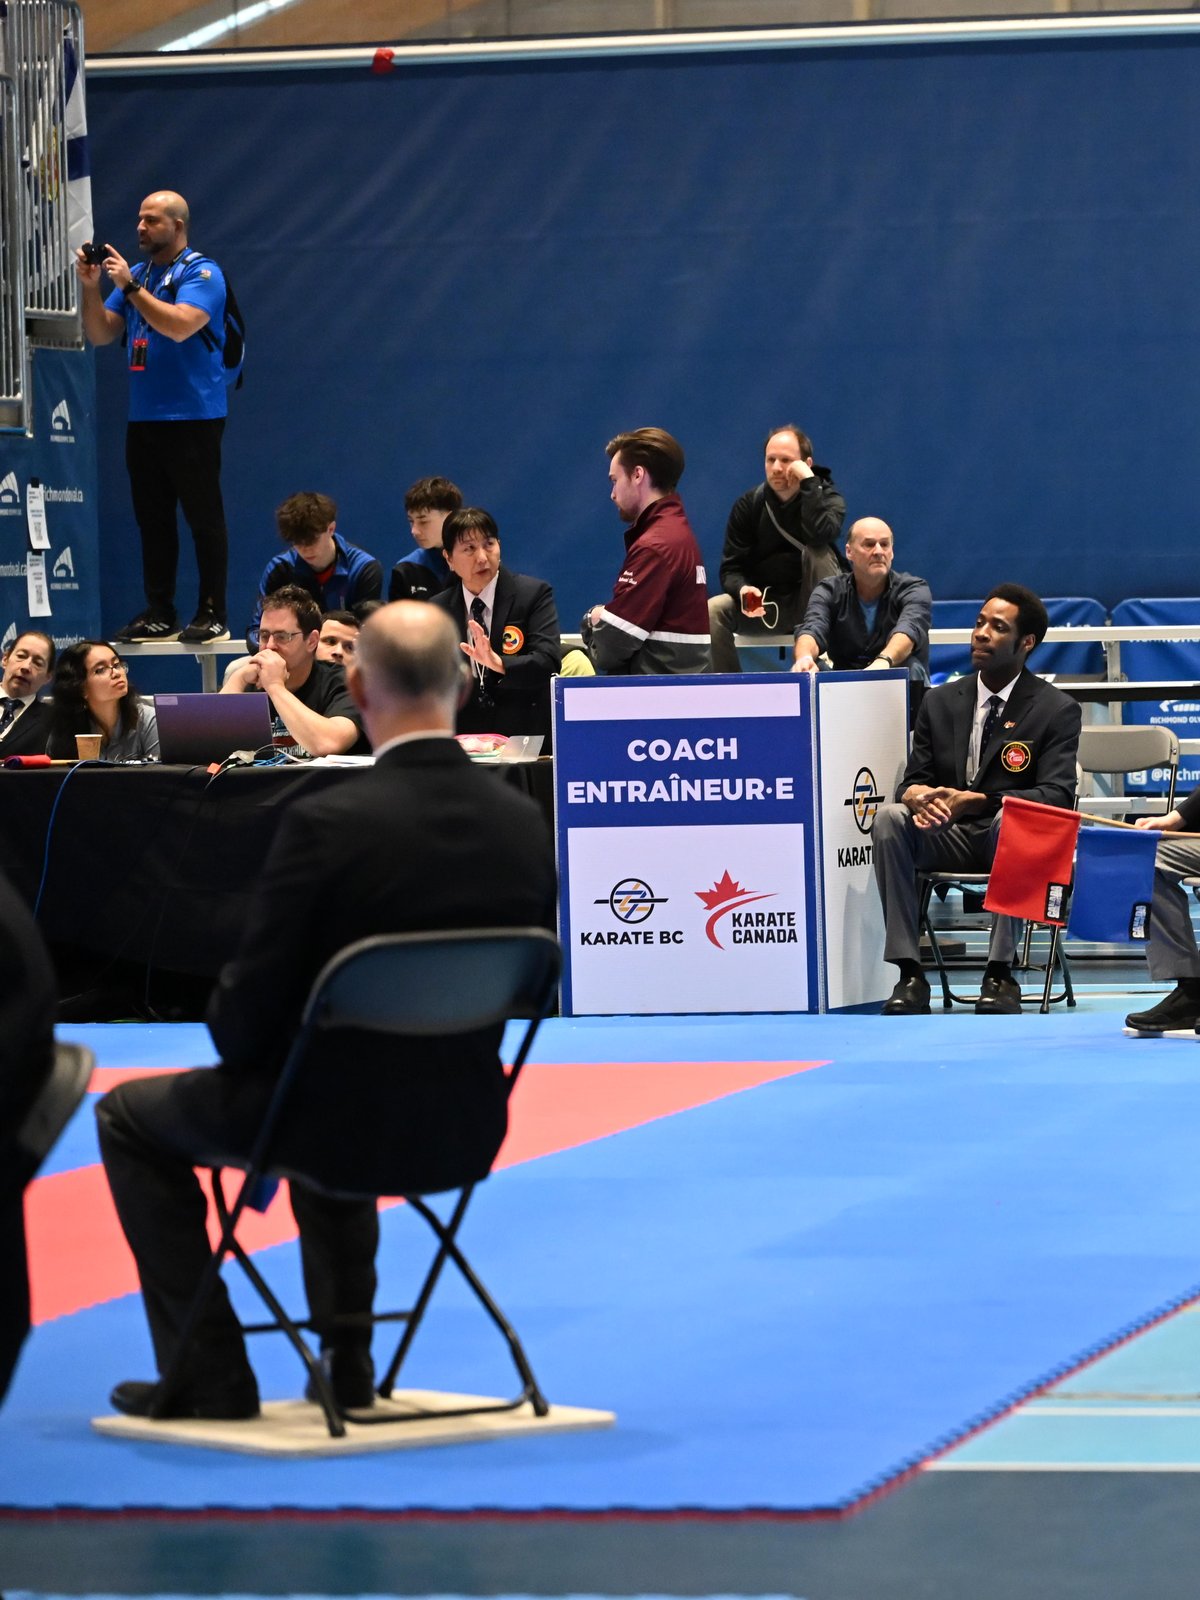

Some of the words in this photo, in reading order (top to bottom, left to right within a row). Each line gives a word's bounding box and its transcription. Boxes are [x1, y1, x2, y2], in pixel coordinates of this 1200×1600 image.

[1150, 716, 1188, 724] RICHMOND
[627, 737, 738, 762] COACH
[731, 912, 796, 928] KARATE
[580, 931, 654, 946] KARATE
[659, 930, 684, 945] BC
[732, 929, 798, 944] CANADA
